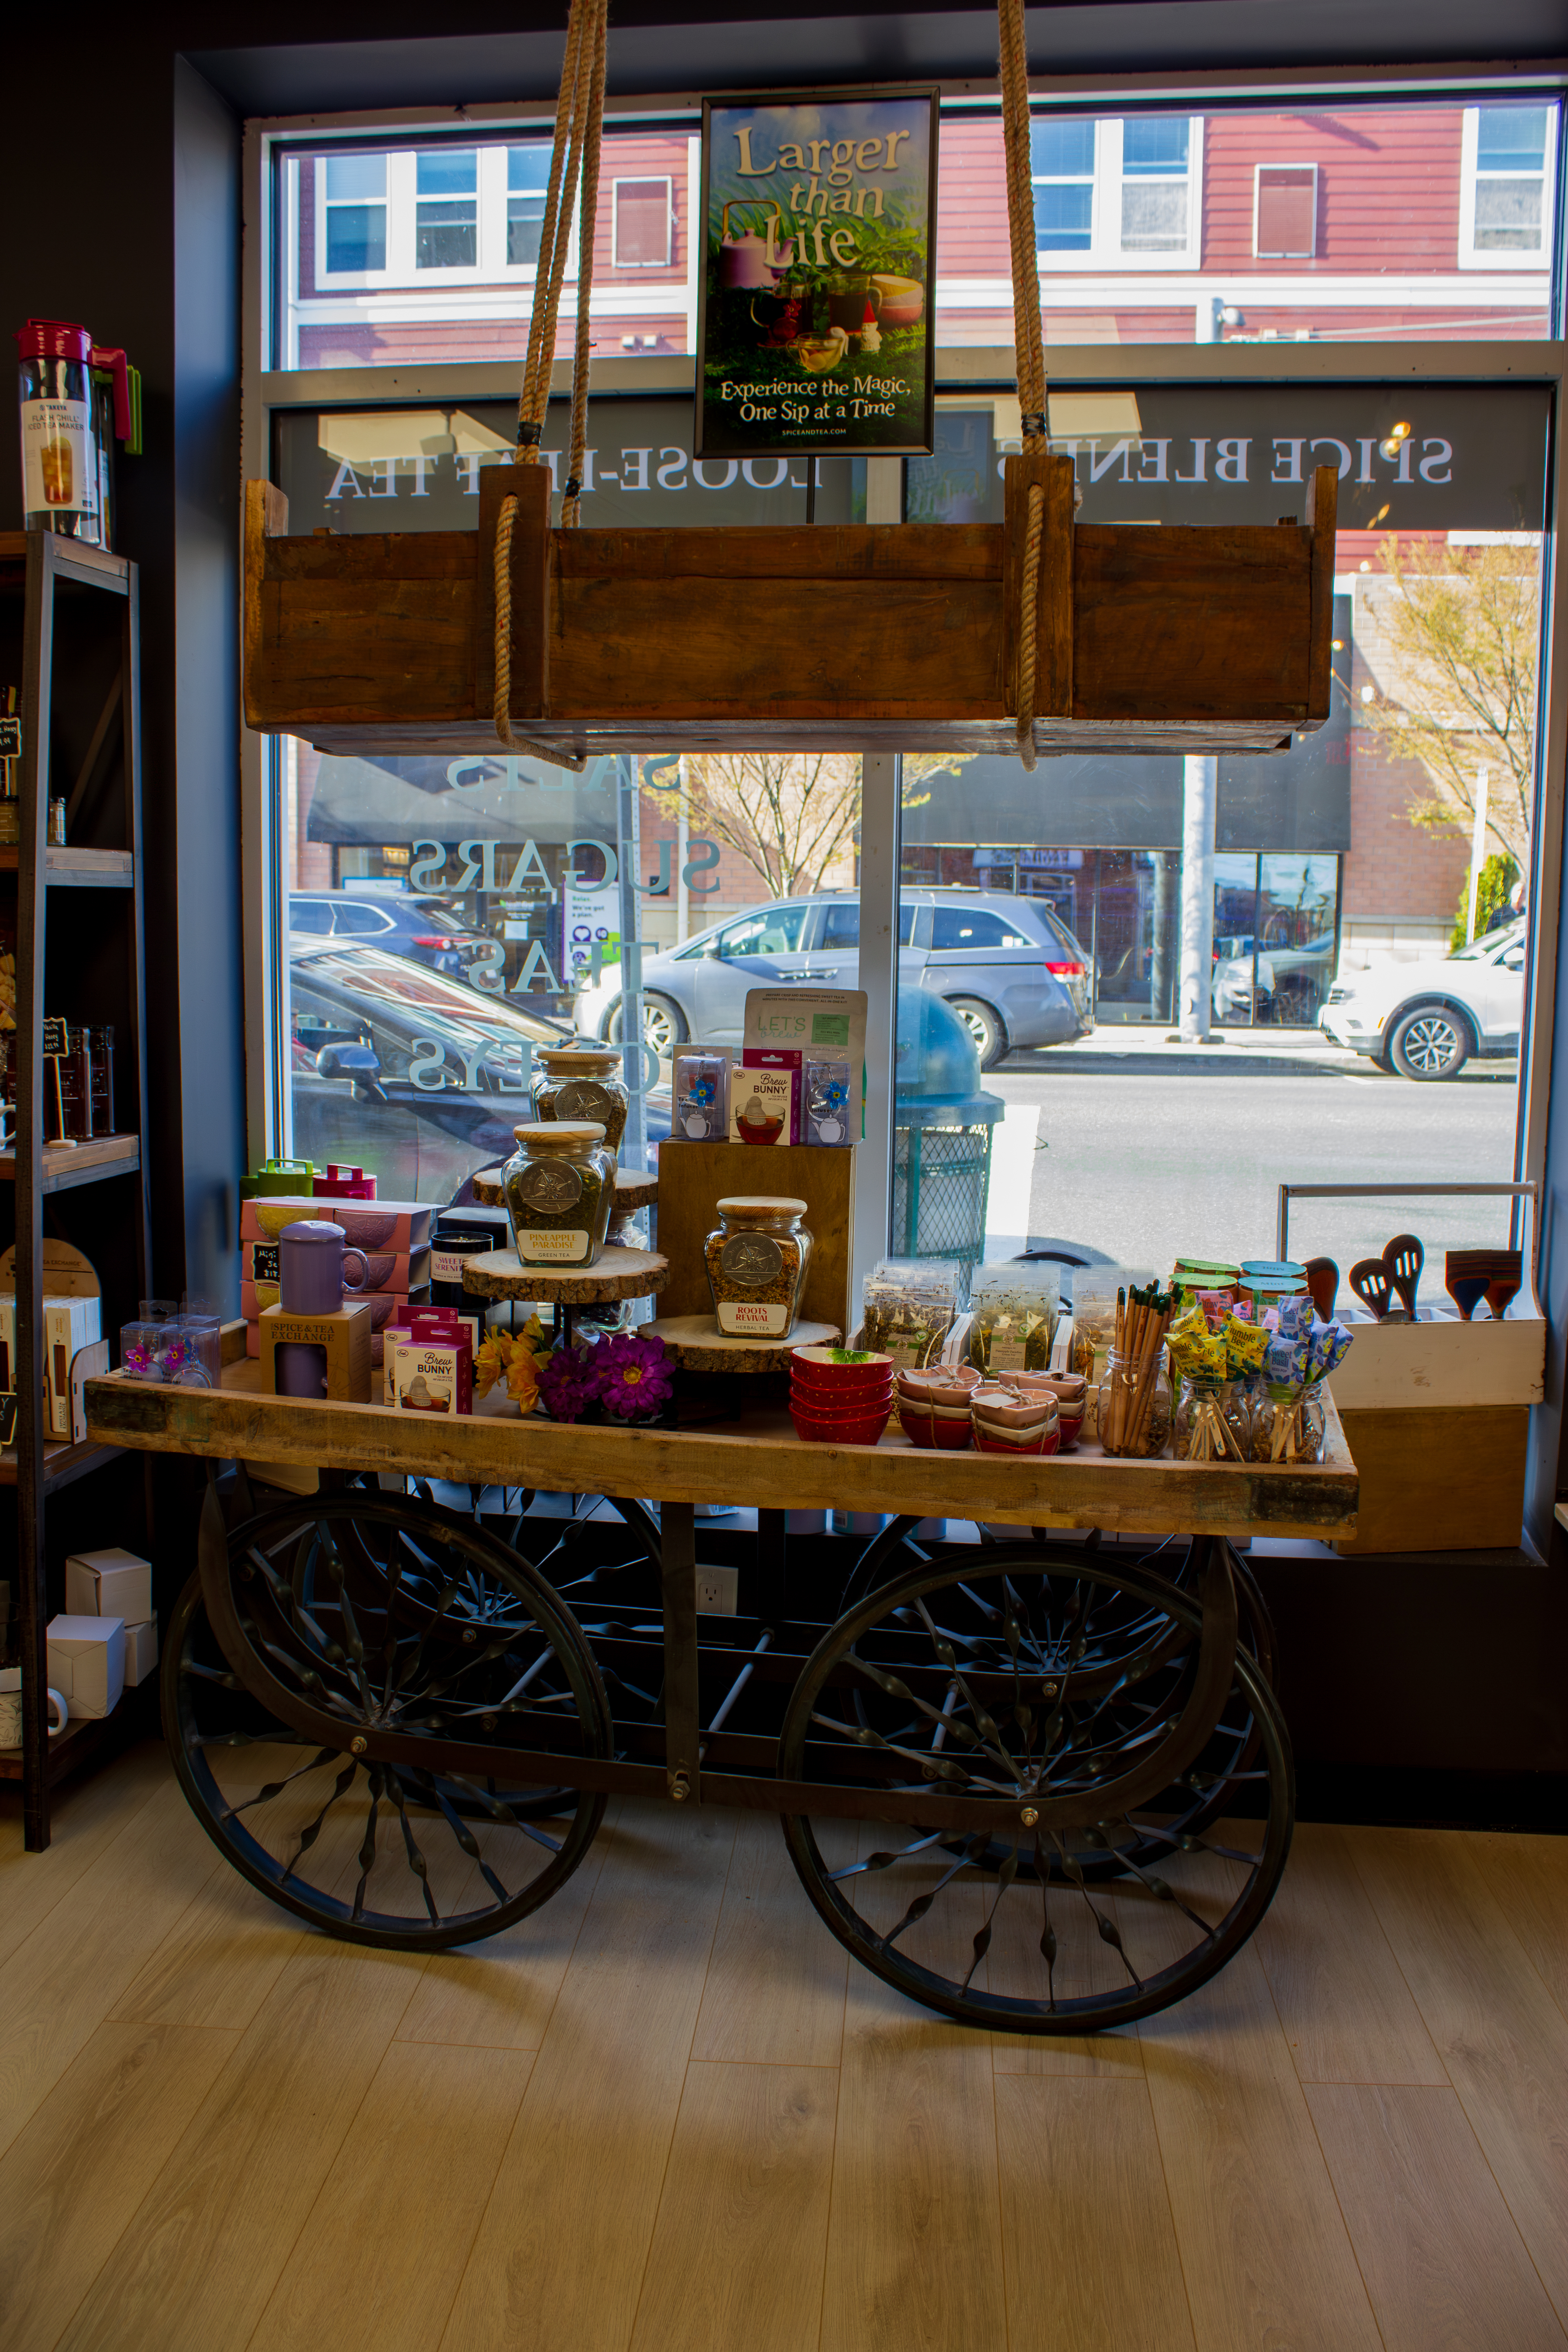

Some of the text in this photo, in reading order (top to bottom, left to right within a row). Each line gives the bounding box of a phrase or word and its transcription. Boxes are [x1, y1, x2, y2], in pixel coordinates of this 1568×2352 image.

[733, 127, 910, 186] Larger
[789, 176, 885, 219] than
[763, 214, 858, 269] Life
[720, 374, 911, 402] Experience the Magic,
[740, 398, 896, 424] One Sip at a Time
[59, 423, 84, 431] MAKER
[758, 1016, 806, 1031] LET'S
[760, 1025, 802, 1039] brew
[760, 1073, 788, 1085] Brew
[754, 1085, 787, 1094] BUNNY
[529, 1234, 578, 1242] PINEAPPLE
[258, 1250, 277, 1259] Mini
[439, 1257, 462, 1265] SWEET
[435, 1263, 462, 1272] SERENIT
[1202, 1300, 1218, 1308] Straw
[736, 1314, 769, 1322] REVIVAL
[1283, 1315, 1296, 1323] Basil
[274, 1323, 303, 1332] SPICE
[304, 1324, 313, 1333] &
[313, 1325, 335, 1334] TEA
[1227, 1323, 1255, 1343] Humble
[271, 1331, 334, 1342] EXCHANGE
[1231, 1335, 1245, 1348] Bee
[1172, 1343, 1192, 1353] umble
[1270, 1348, 1293, 1359] Sweet
[424, 1352, 453, 1365] Brew
[1178, 1352, 1190, 1360] Bee
[1271, 1354, 1289, 1368] Basil
[417, 1364, 452, 1375] BUNNY
[1227, 1367, 1237, 1376] lant
